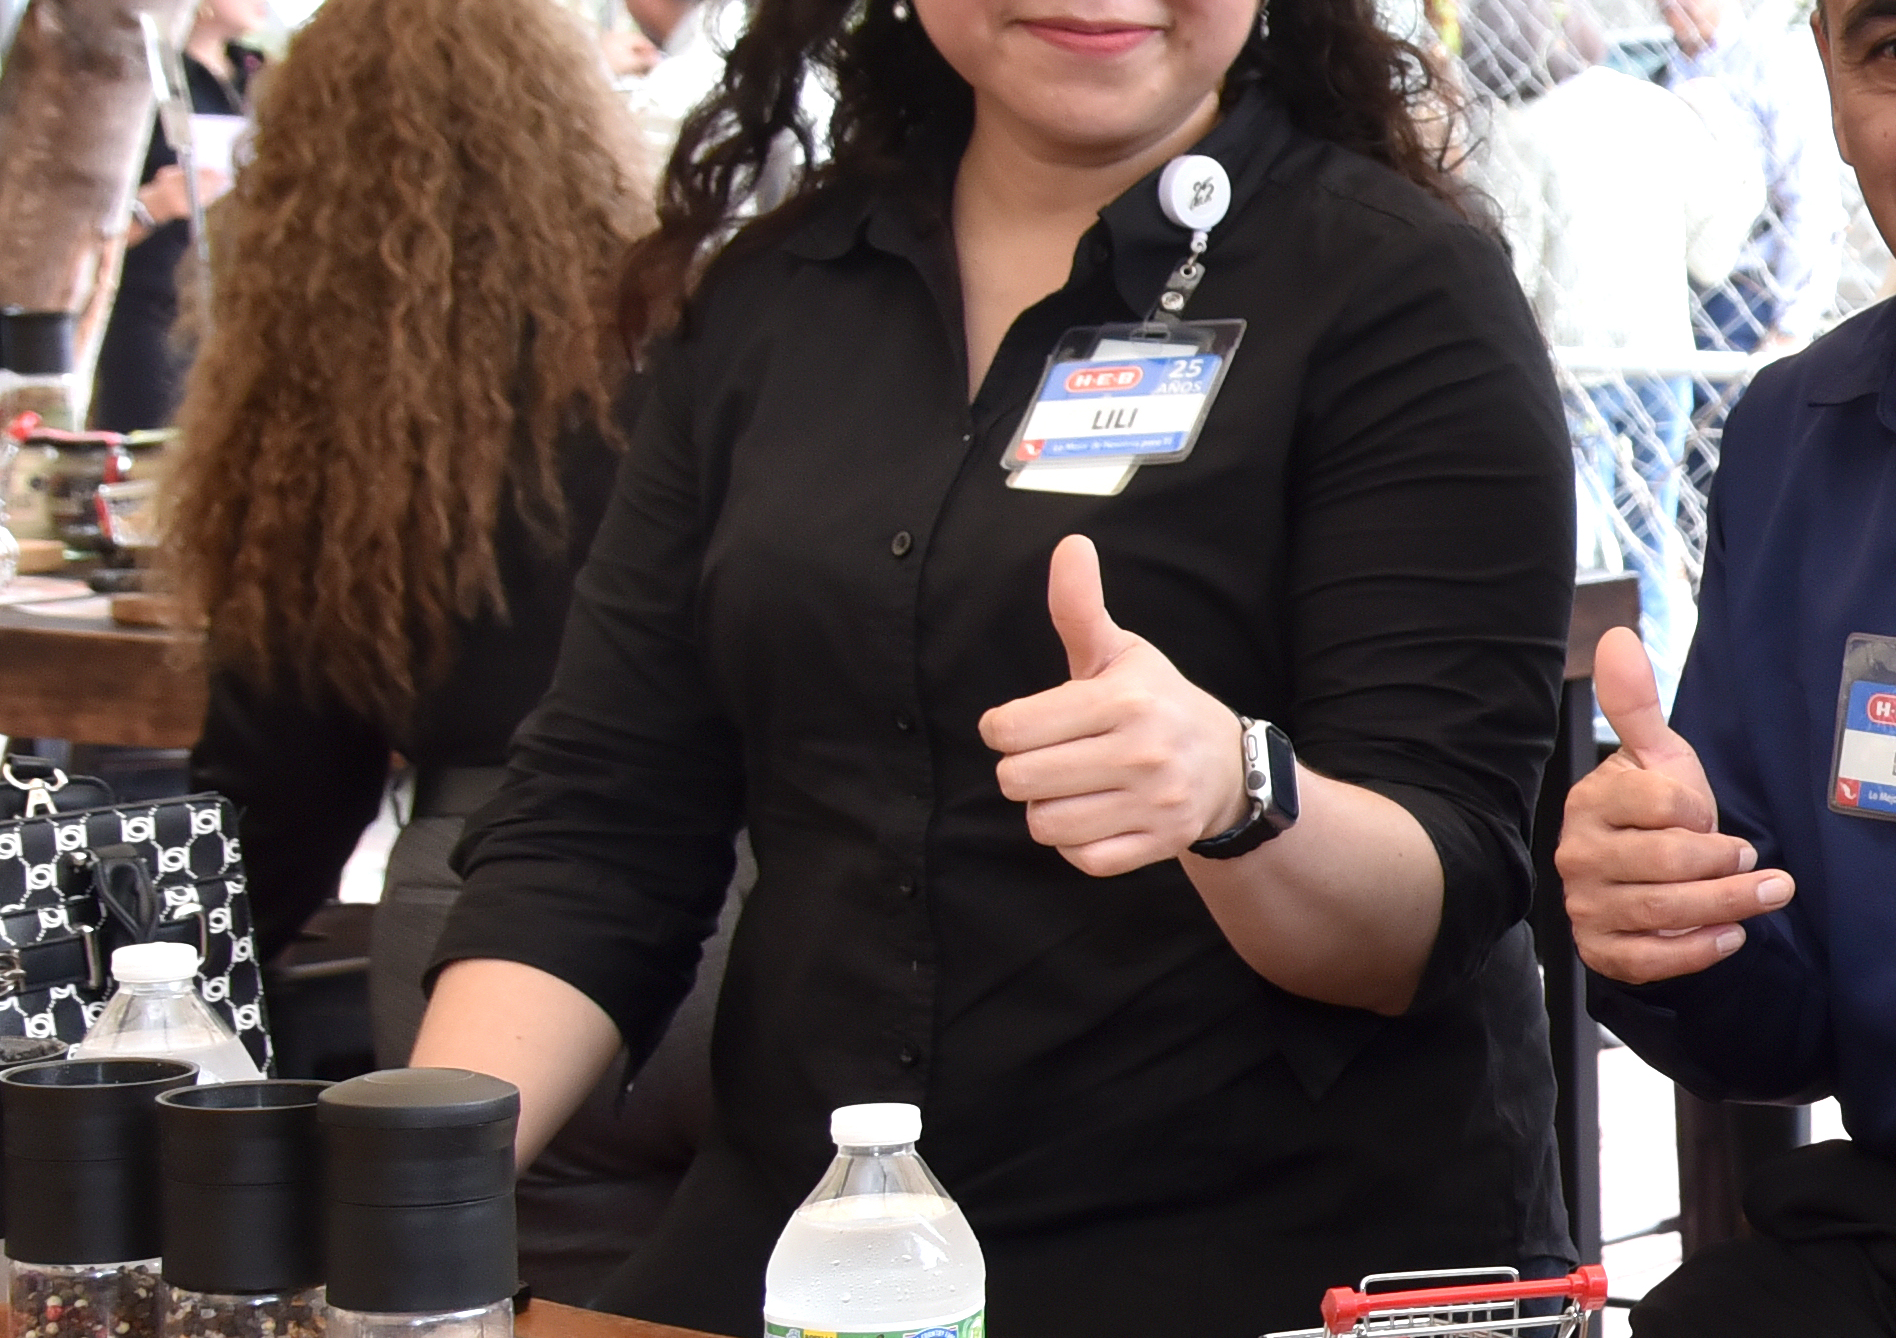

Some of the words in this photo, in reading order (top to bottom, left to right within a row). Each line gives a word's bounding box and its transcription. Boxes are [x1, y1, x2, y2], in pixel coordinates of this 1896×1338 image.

[1168, 359, 1204, 378] 25
[1156, 380, 1203, 394] AÑOS
[1091, 408, 1138, 430] LILI
[1868, 790, 1878, 801] Lo
